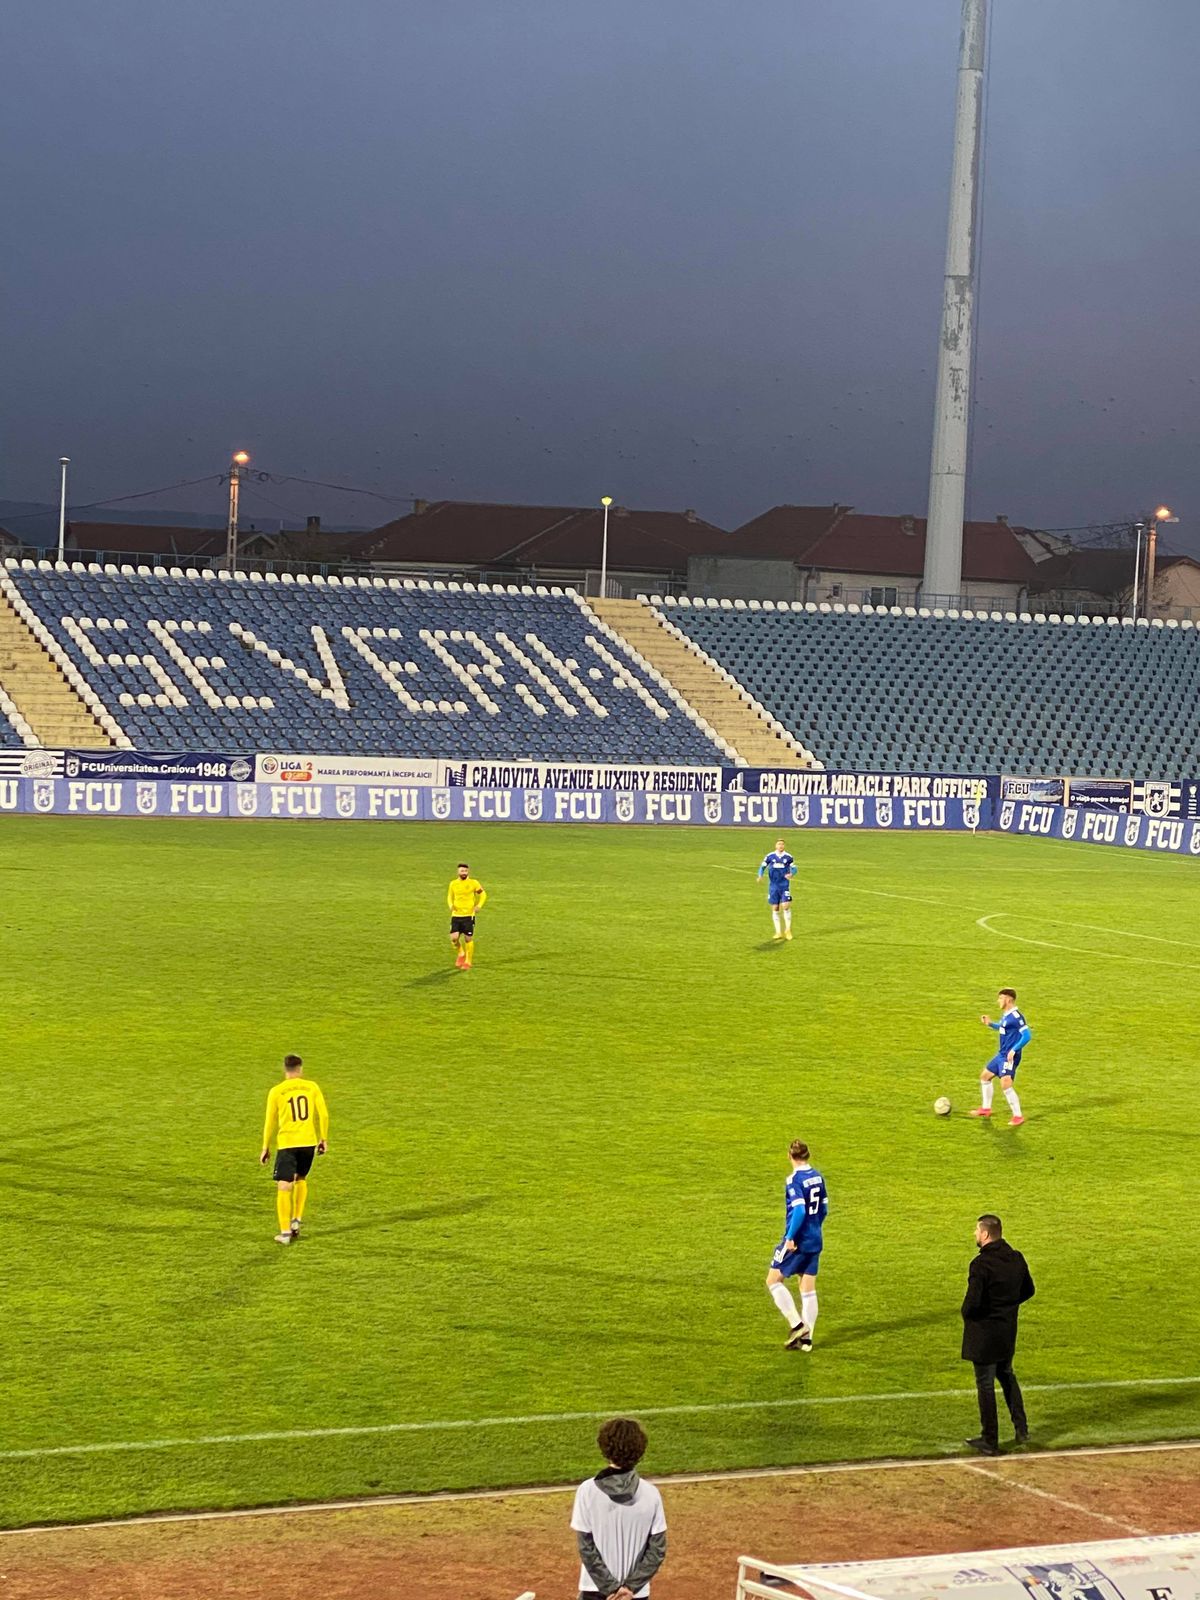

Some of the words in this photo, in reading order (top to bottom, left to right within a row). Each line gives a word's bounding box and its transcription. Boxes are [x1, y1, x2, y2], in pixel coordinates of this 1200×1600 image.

[24, 761, 54, 771] ORIGINAL
[82, 762, 158, 774] FCUniversitatea
[160, 764, 196, 774] Craiova
[196, 762, 227, 777] 1948
[280, 762, 302, 770] LIGA
[306, 762, 313, 770] 2
[472, 767, 540, 788] CRAIOVITA
[544, 768, 594, 789] AVENUE
[596, 769, 650, 790] LUXURY
[653, 771, 718, 792] RESIDENCE
[760, 773, 828, 795] CRAIOVITA
[830, 774, 891, 797] MIRACLE
[893, 776, 931, 798] PARK
[933, 778, 988, 799] OFFICES
[68, 782, 122, 811] FCU
[170, 784, 223, 813] FCU
[271, 786, 322, 815] FCU
[368, 788, 418, 817] FCU
[463, 790, 512, 818] FCU
[554, 792, 602, 819] FCU
[646, 793, 692, 821] FCU
[733, 796, 778, 823] FCU
[820, 798, 864, 825] FCU
[903, 799, 946, 826] FCU
[1019, 805, 1055, 833] FCU
[1082, 813, 1119, 842] FCU
[1145, 820, 1184, 850] FCU
[287, 1095, 309, 1122] 10
[808, 1187, 820, 1215] 5
